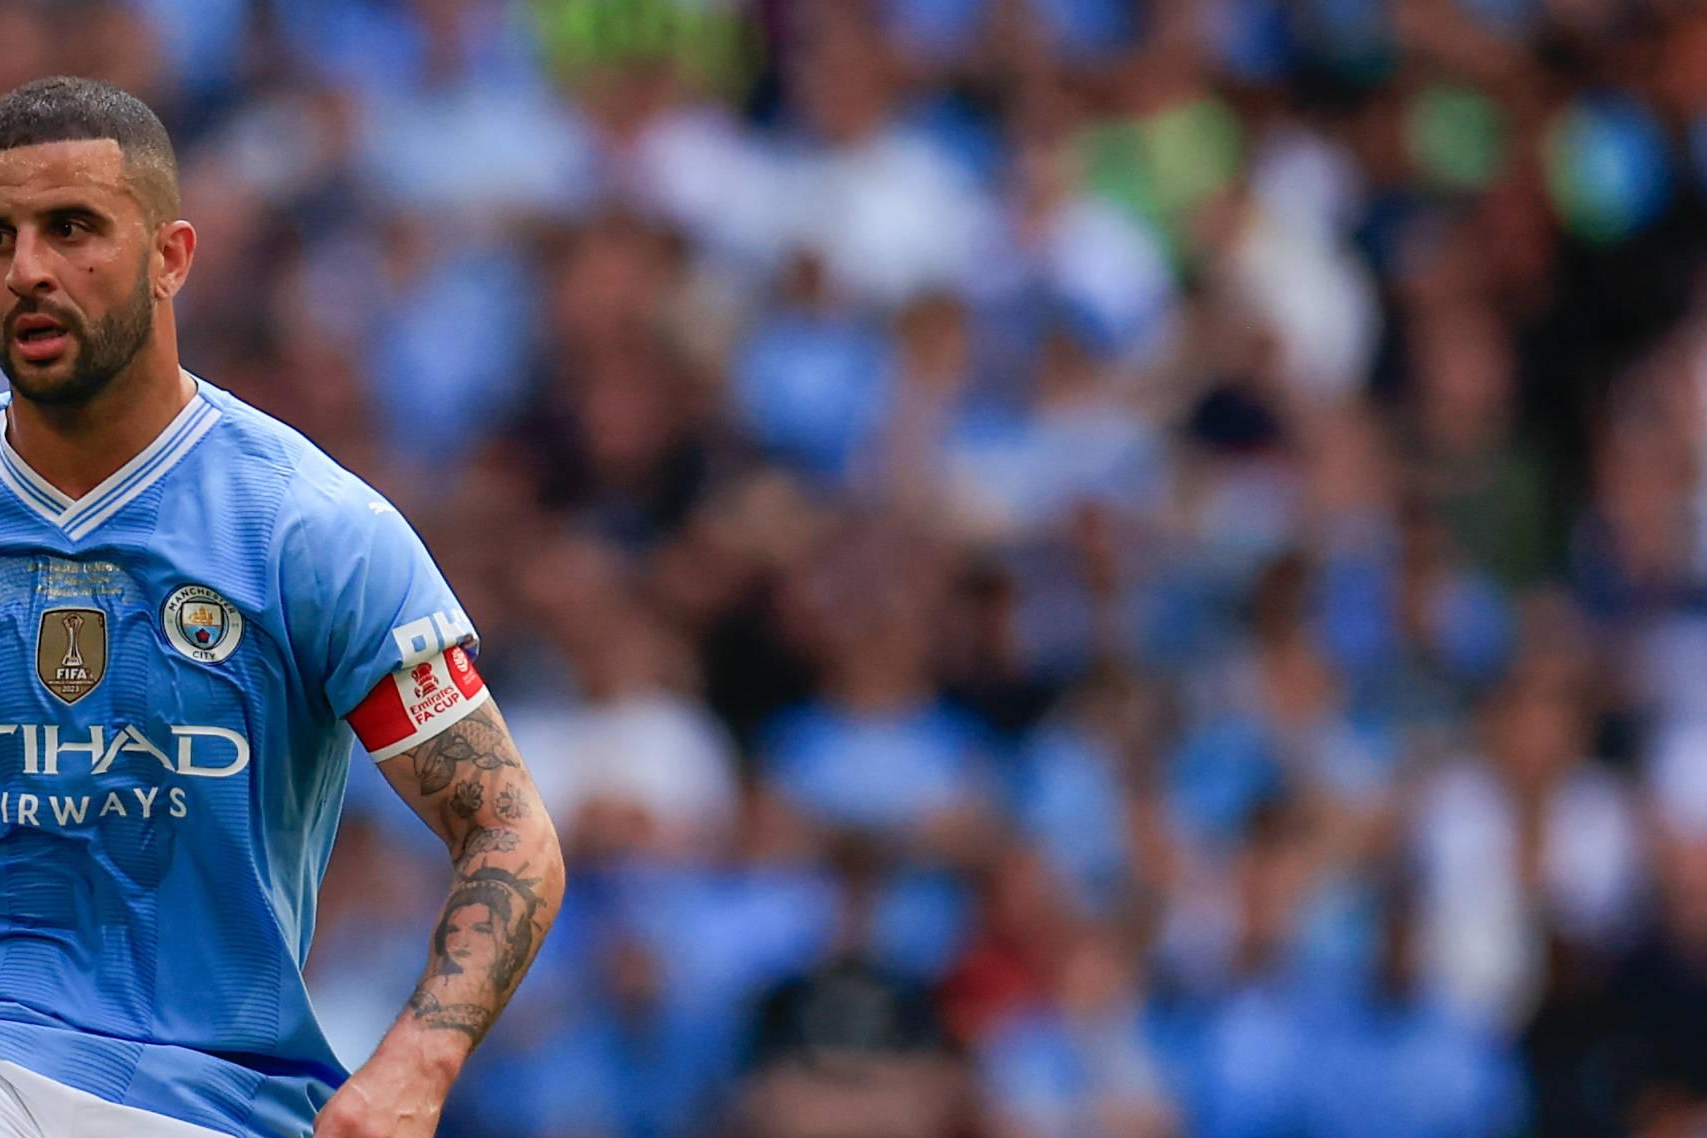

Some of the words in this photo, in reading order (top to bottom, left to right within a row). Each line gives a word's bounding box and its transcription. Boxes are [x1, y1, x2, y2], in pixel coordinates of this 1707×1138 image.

[168, 587, 235, 614] MANCHESTER
[192, 650, 216, 660] CITY
[56, 668, 87, 680] FIFA
[409, 685, 455, 715] Emirates
[415, 710, 435, 725] FA
[434, 692, 460, 713] CUP
